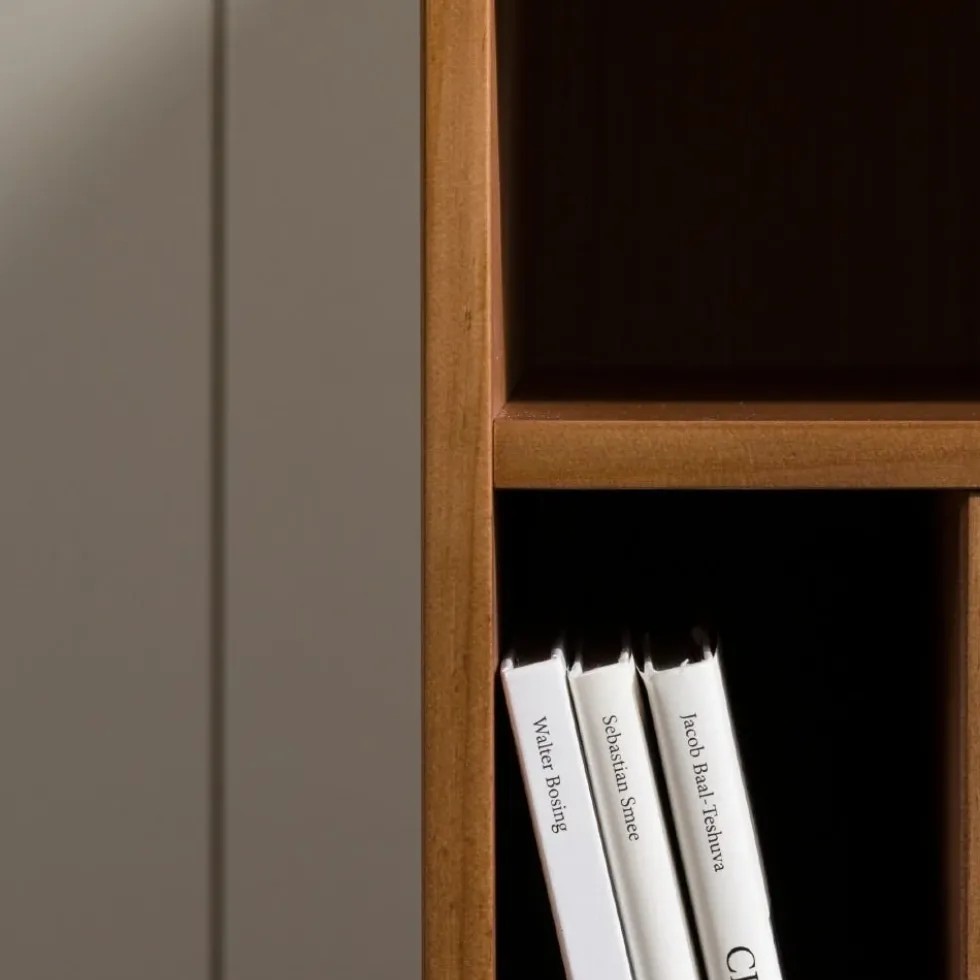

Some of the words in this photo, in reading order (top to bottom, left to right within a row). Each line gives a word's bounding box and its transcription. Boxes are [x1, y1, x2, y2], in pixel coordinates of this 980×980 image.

[532, 716, 554, 772] Walter
[545, 775, 567, 834] Bosing
[602, 714, 628, 794] Sebastian
[620, 796, 640, 842] Smee
[680, 712, 704, 758] Jacob
[693, 762, 724, 873] Baal-Teshuva
